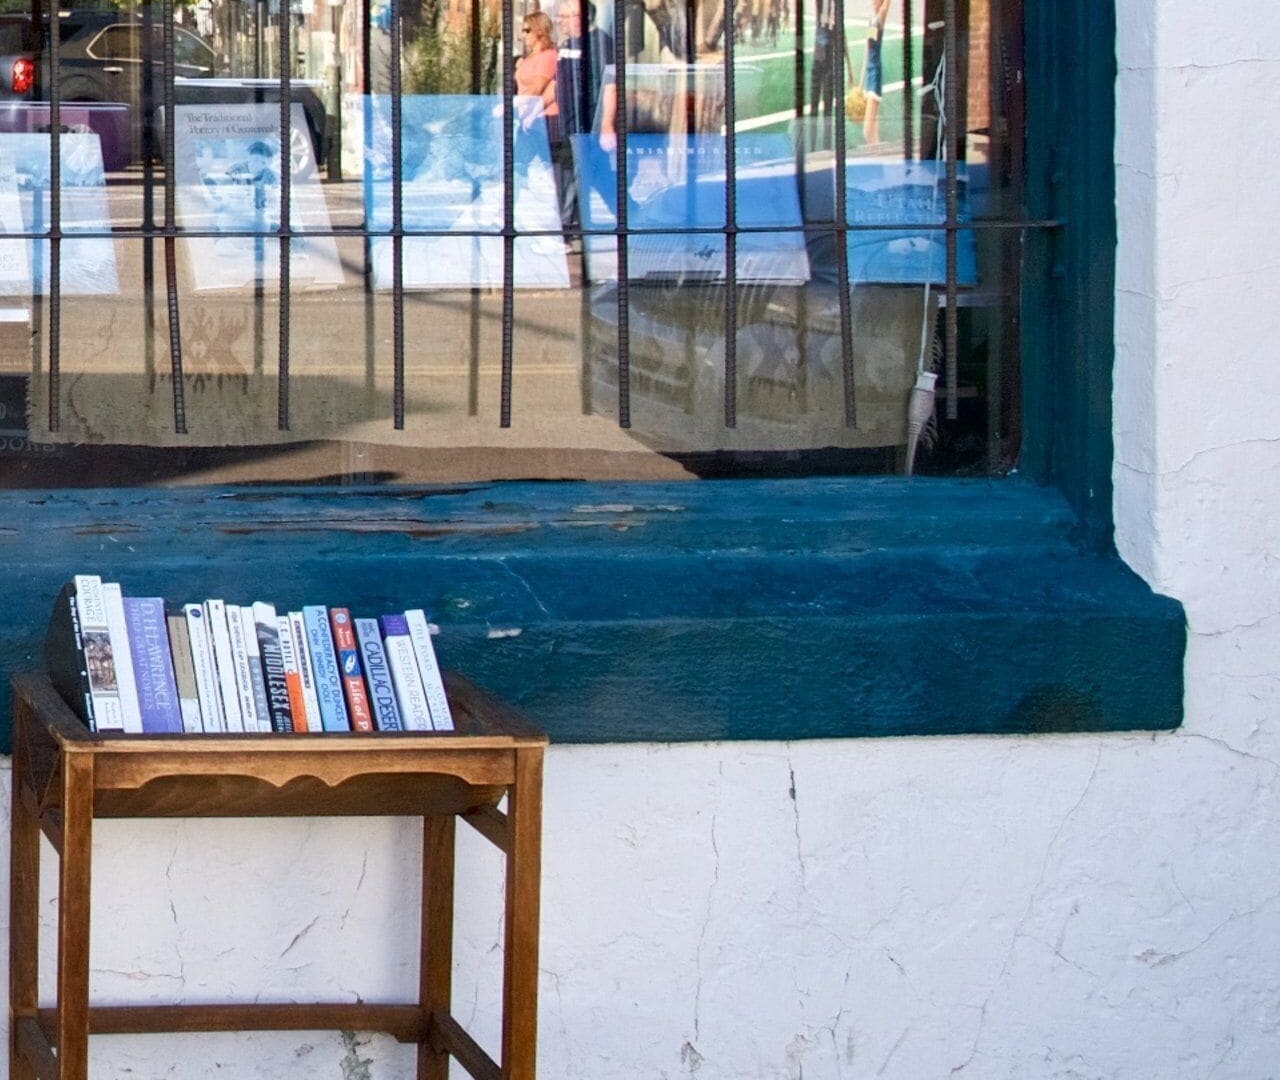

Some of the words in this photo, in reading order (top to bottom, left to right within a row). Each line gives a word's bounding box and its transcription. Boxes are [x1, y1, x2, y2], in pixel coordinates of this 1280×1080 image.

[627, 147, 705, 155] ANISHING
[855, 211, 964, 224] REFLECTIS
[81, 579, 94, 621] COURAGE
[283, 640, 293, 664] BOYLE
[318, 617, 336, 673] CONFEDERACY
[420, 644, 432, 673] ROAD
[146, 634, 171, 710] LAWRENCE
[264, 643, 290, 709] MIDDLESEX
[329, 675, 338, 686] OF
[364, 641, 391, 694] CADILLAC
[141, 670, 154, 710] NOVELS
[350, 680, 362, 704] Life
[397, 640, 415, 687] WESTERN
[409, 688, 428, 729] READER
[332, 690, 344, 721] DUNCES
[355, 705, 367, 718] of
[358, 721, 369, 731] P
